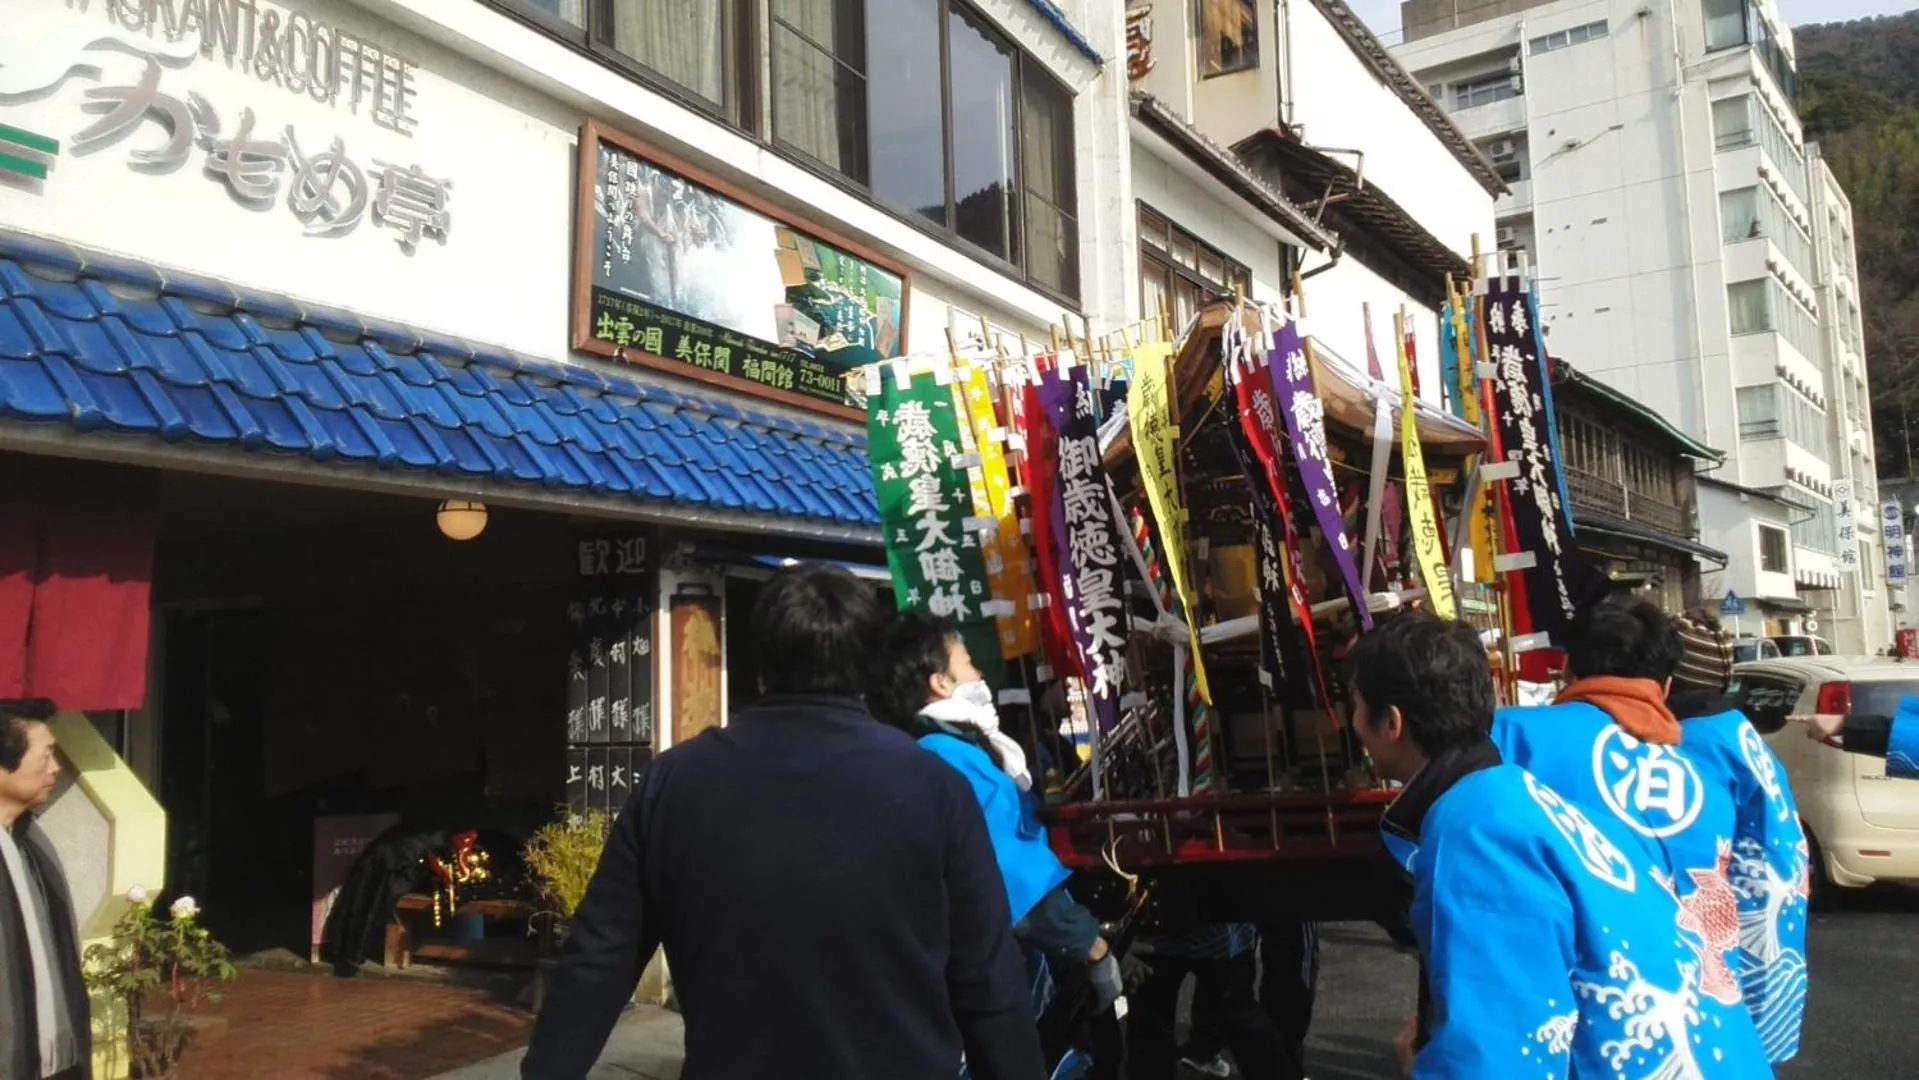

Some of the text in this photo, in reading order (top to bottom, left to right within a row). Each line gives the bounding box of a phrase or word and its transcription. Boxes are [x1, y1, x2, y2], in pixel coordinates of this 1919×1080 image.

[70, 55, 454, 257] かもめ亭
[742, 354, 794, 389] 福間館
[800, 368, 841, 393] 73-0011
[1058, 436, 1126, 699] 御歳徳皇大神
[1608, 735, 1686, 821] 泊
